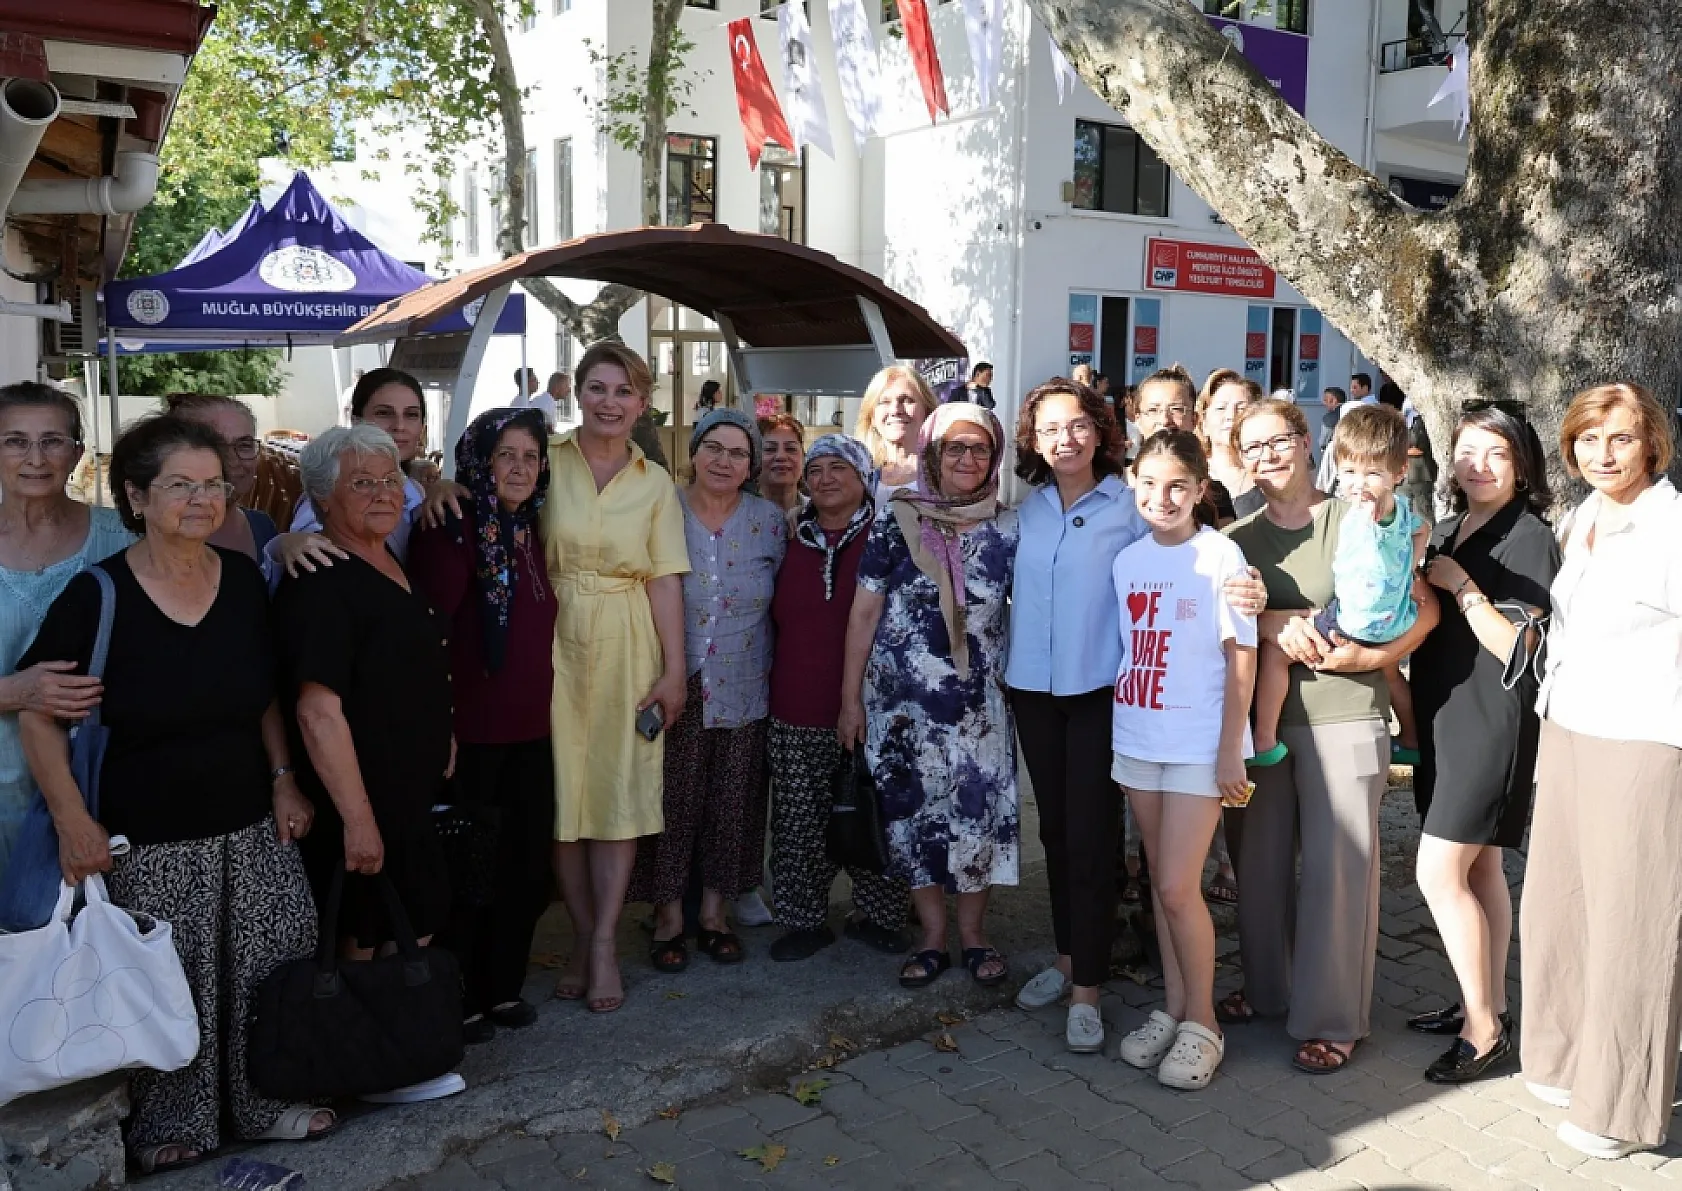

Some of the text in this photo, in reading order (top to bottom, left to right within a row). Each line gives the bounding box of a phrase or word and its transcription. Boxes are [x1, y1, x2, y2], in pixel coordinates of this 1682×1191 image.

[1154, 270, 1174, 282] CHP
[202, 300, 260, 315] MUĞLA
[263, 301, 357, 319] BÜYÜKŞEHİR
[1070, 355, 1092, 366] CHP
[1135, 357, 1156, 367] CHP
[1246, 360, 1265, 371] CHP
[1299, 362, 1318, 373] CHP
[1131, 630, 1172, 668] URE
[1115, 668, 1165, 710] LOVE
